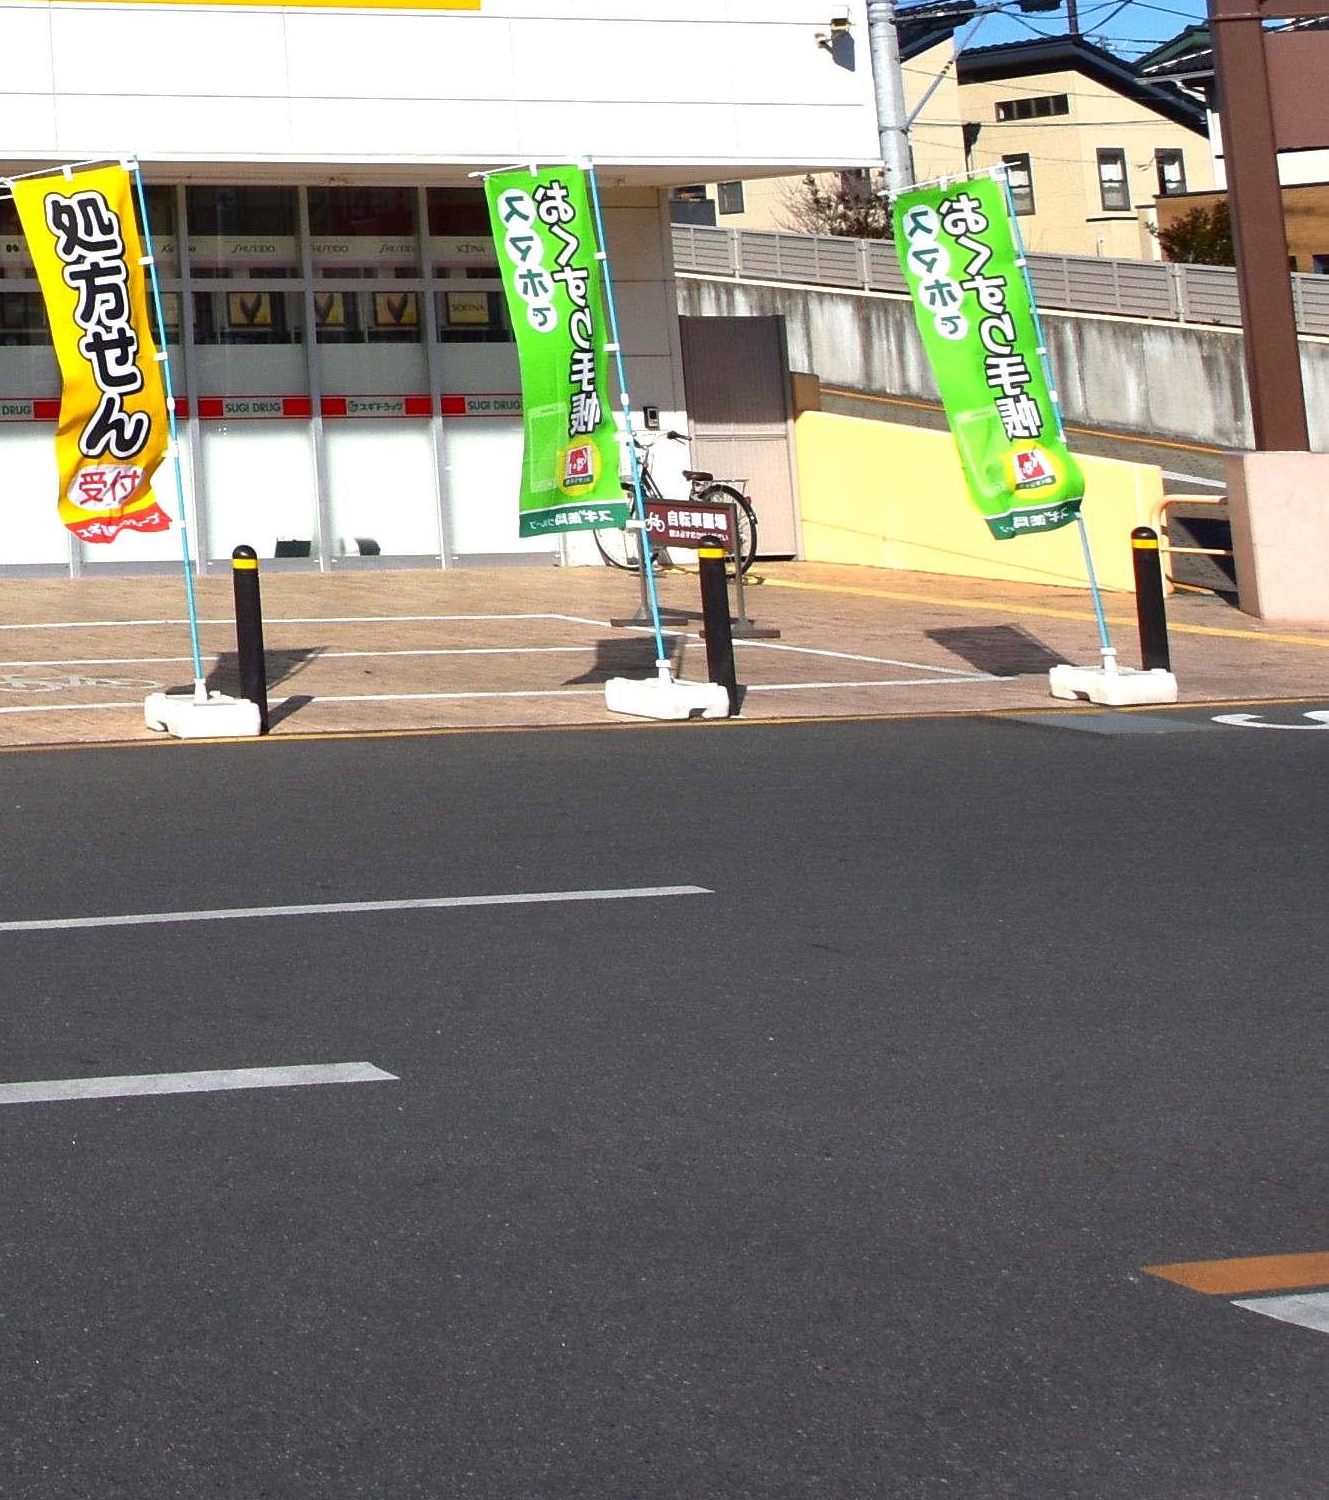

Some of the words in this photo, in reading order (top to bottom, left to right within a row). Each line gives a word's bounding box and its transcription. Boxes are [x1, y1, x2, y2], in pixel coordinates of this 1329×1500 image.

[44, 192, 150, 460] 処方せん
[1, 405, 32, 416] DRUG
[225, 403, 249, 413] SUGI
[252, 402, 281, 413] DRUG
[467, 401, 491, 411] SUGI
[494, 400, 521, 411] DRUG
[78, 470, 140, 505] 受付
[667, 510, 728, 531] 自転車置場
